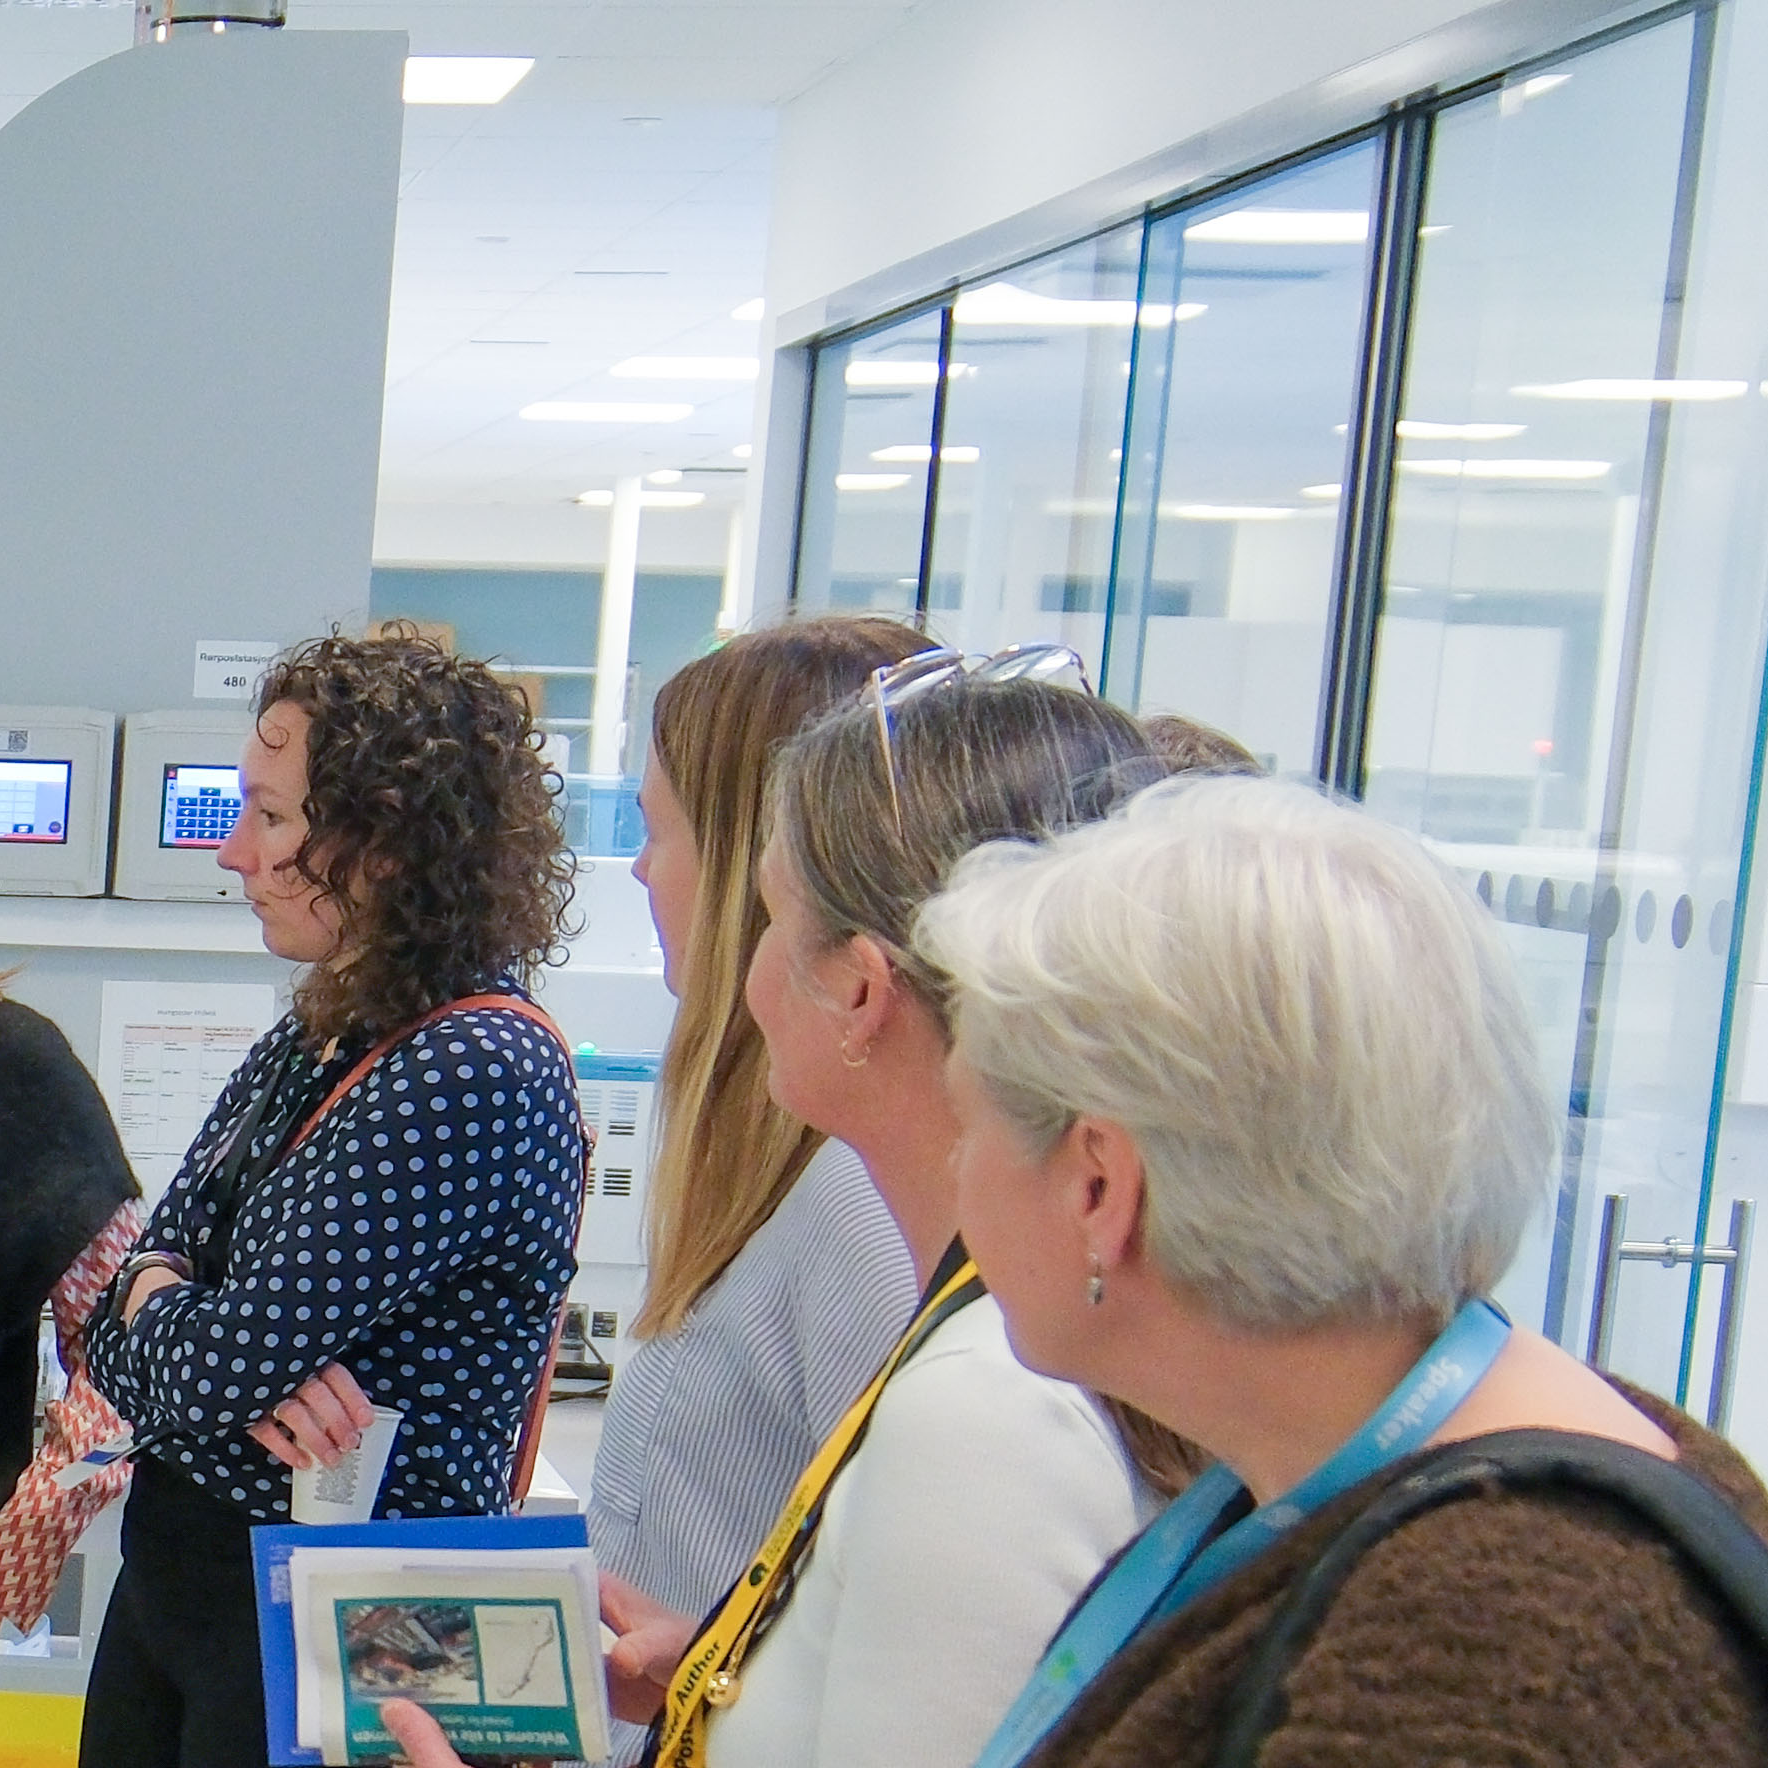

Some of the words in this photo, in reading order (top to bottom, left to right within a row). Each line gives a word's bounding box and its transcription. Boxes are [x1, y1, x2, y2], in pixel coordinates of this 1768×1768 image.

[223, 676, 246, 687] 480
[1376, 1356, 1464, 1451] Speaker
[676, 1641, 720, 1707] Author
